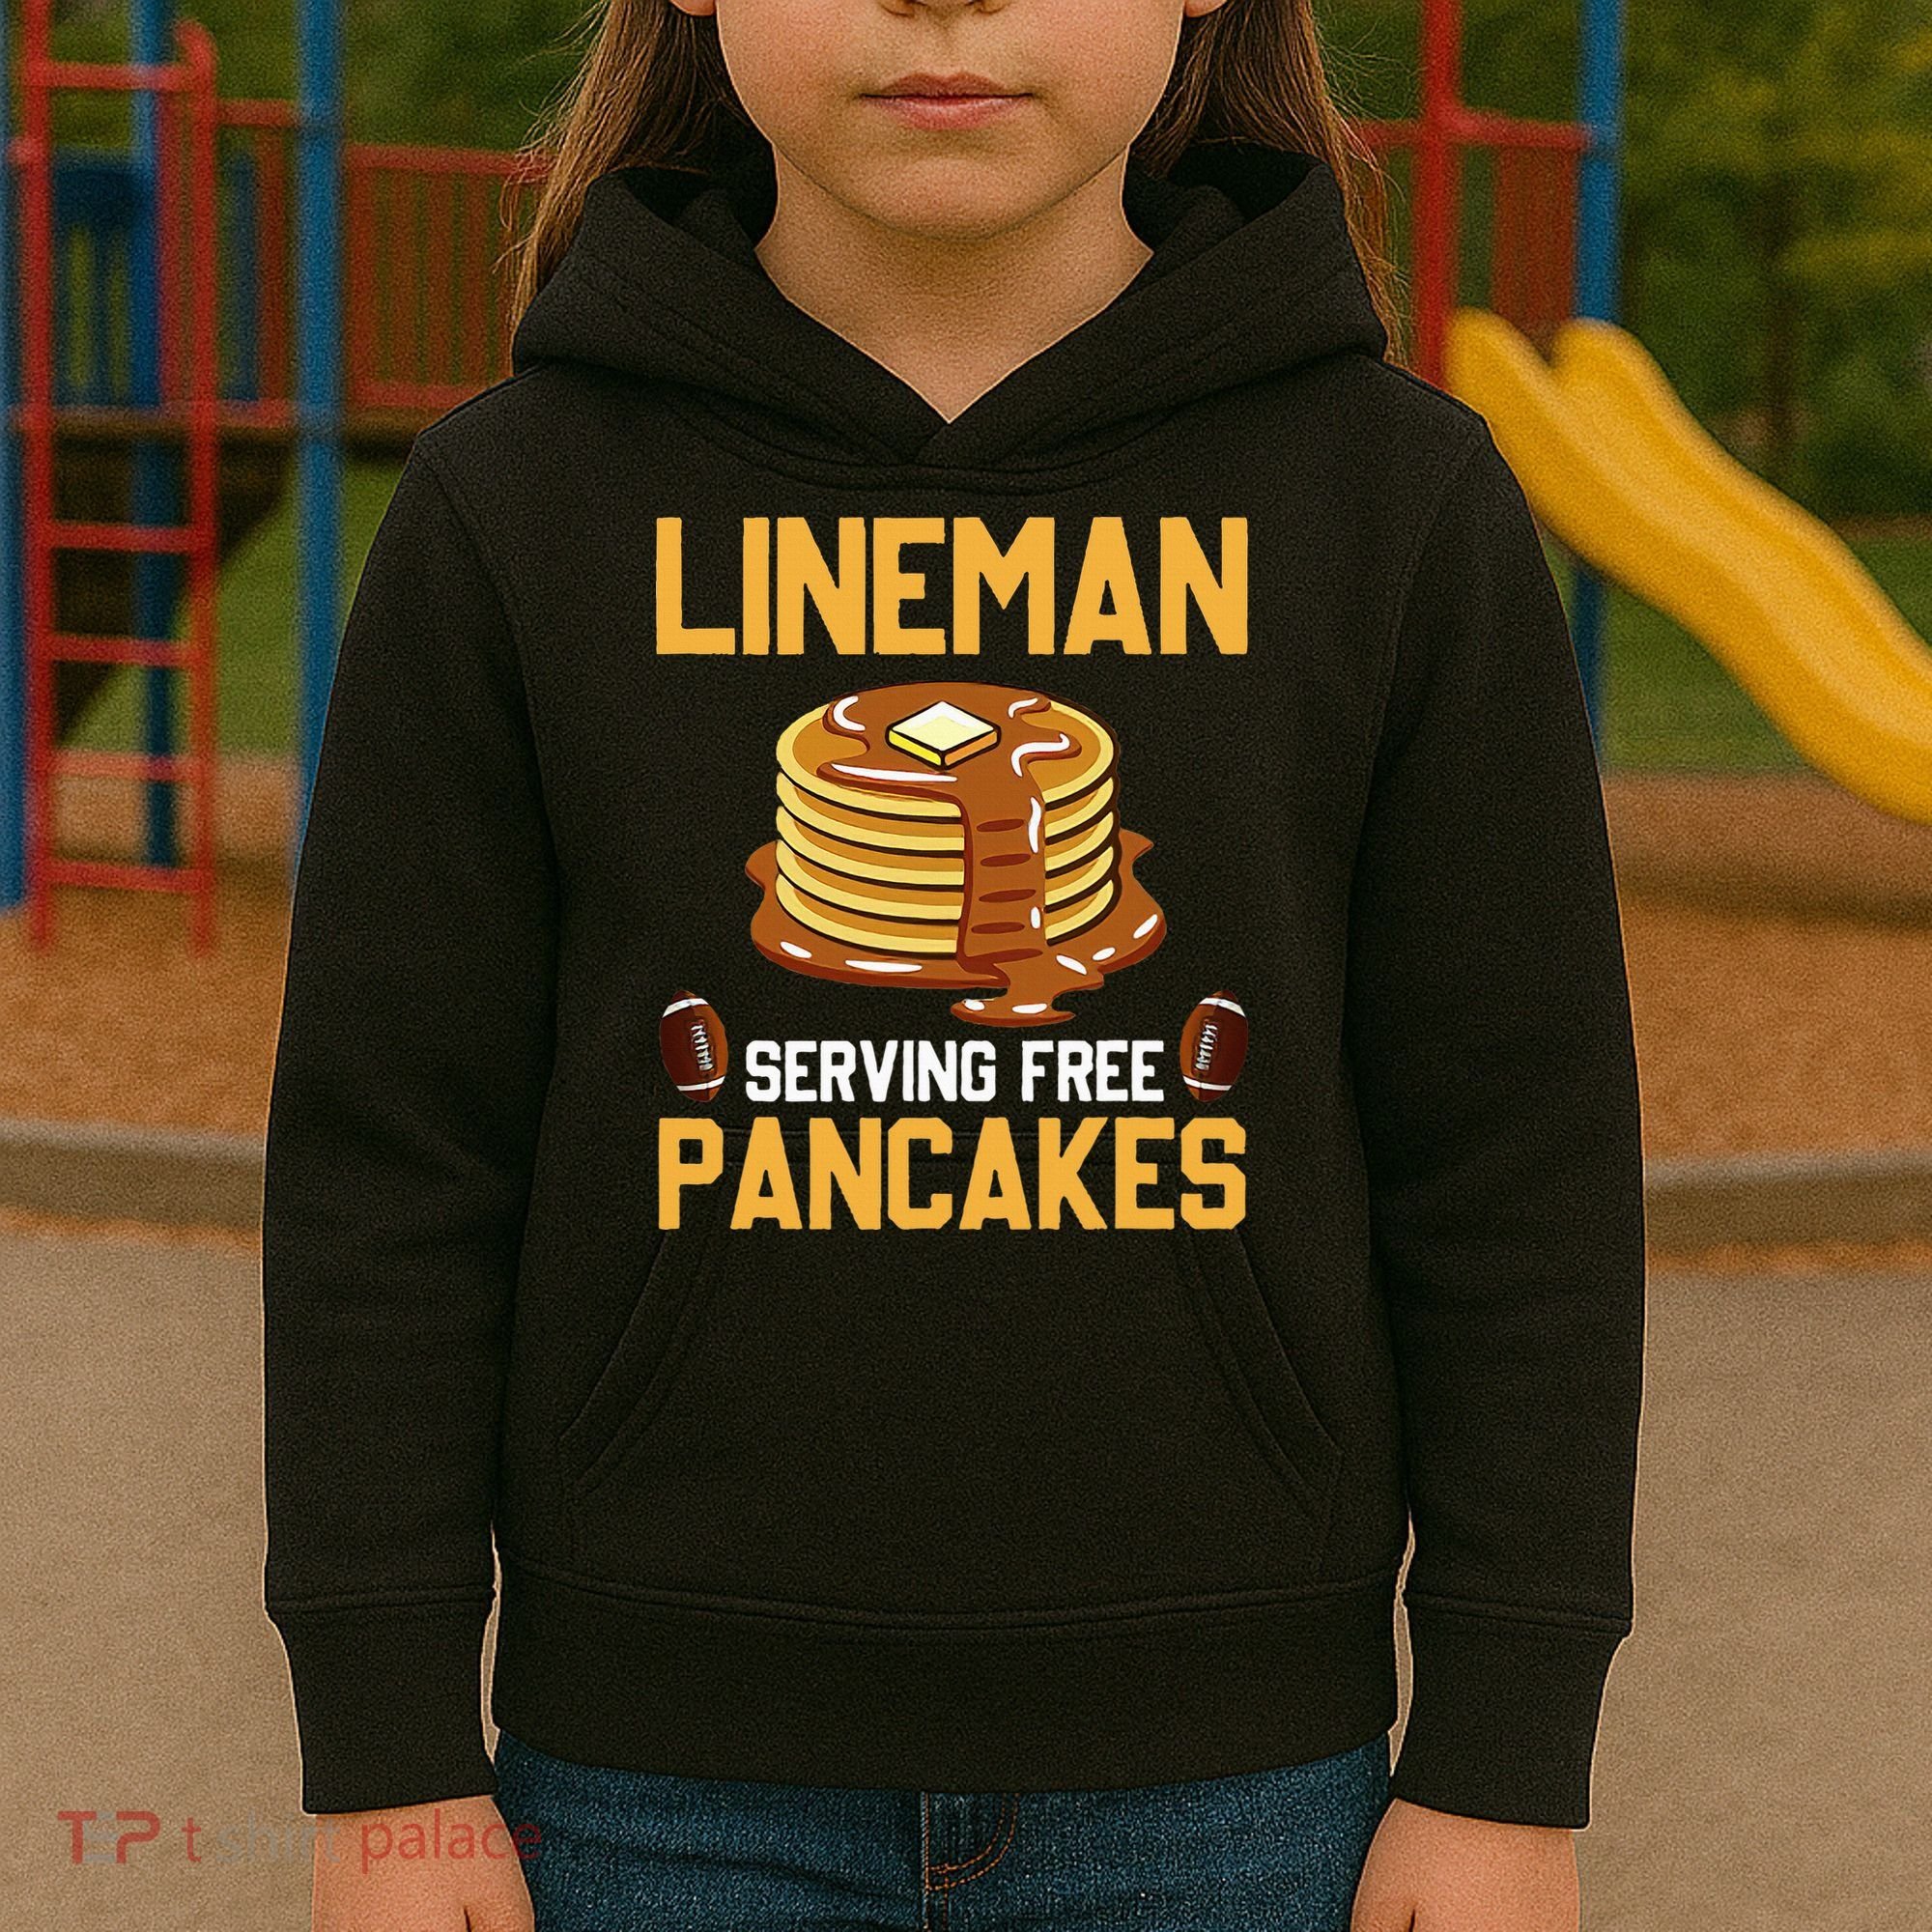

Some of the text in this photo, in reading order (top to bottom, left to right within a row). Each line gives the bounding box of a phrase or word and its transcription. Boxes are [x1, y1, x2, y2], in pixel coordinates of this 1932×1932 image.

[656, 517, 1248, 655] LINEMAN
[746, 1040, 1164, 1102] SERVING FREE
[659, 1117, 1247, 1230] PANCAKES
